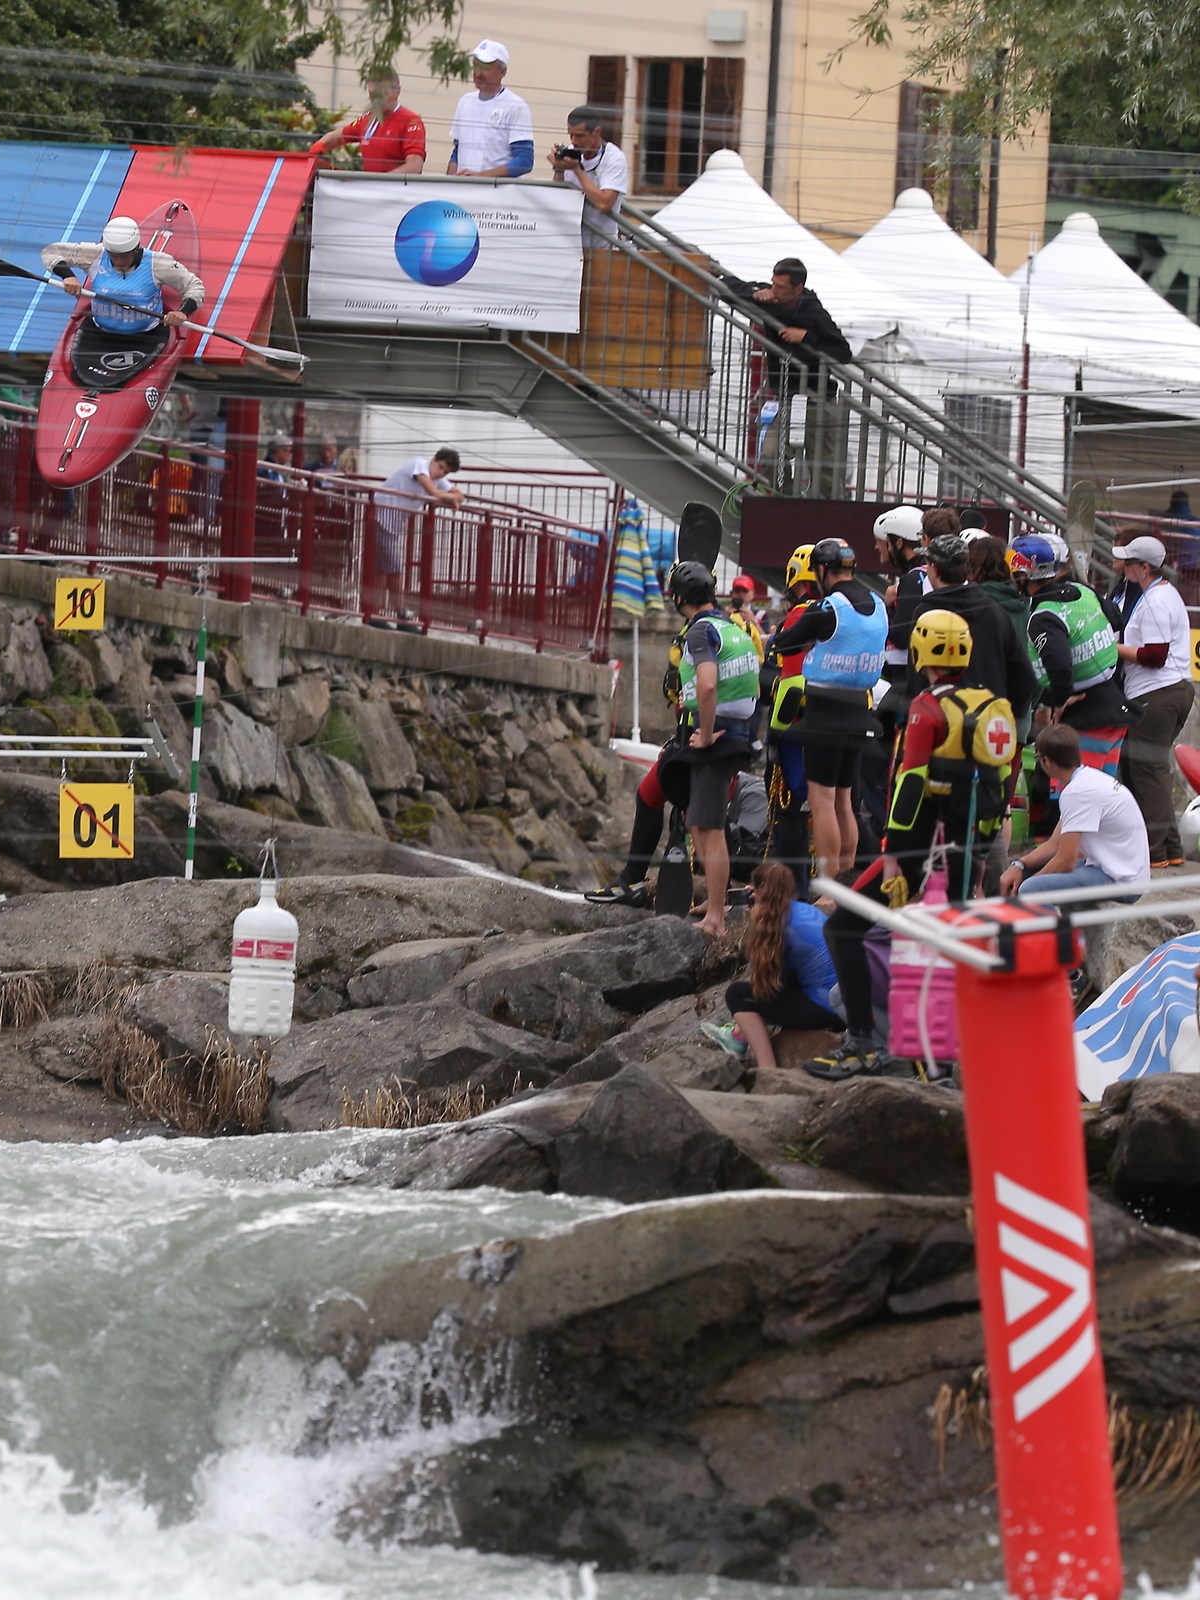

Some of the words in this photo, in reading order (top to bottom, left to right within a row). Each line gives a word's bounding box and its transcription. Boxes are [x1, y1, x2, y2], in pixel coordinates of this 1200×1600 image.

[443, 209, 493, 220] Whitewater
[495, 211, 519, 221] Parks
[478, 220, 537, 231] International
[344, 298, 399, 311] innovation
[419, 300, 451, 316] design
[472, 303, 541, 320] sustainability
[66, 587, 96, 619] 10
[72, 803, 121, 848] 01
